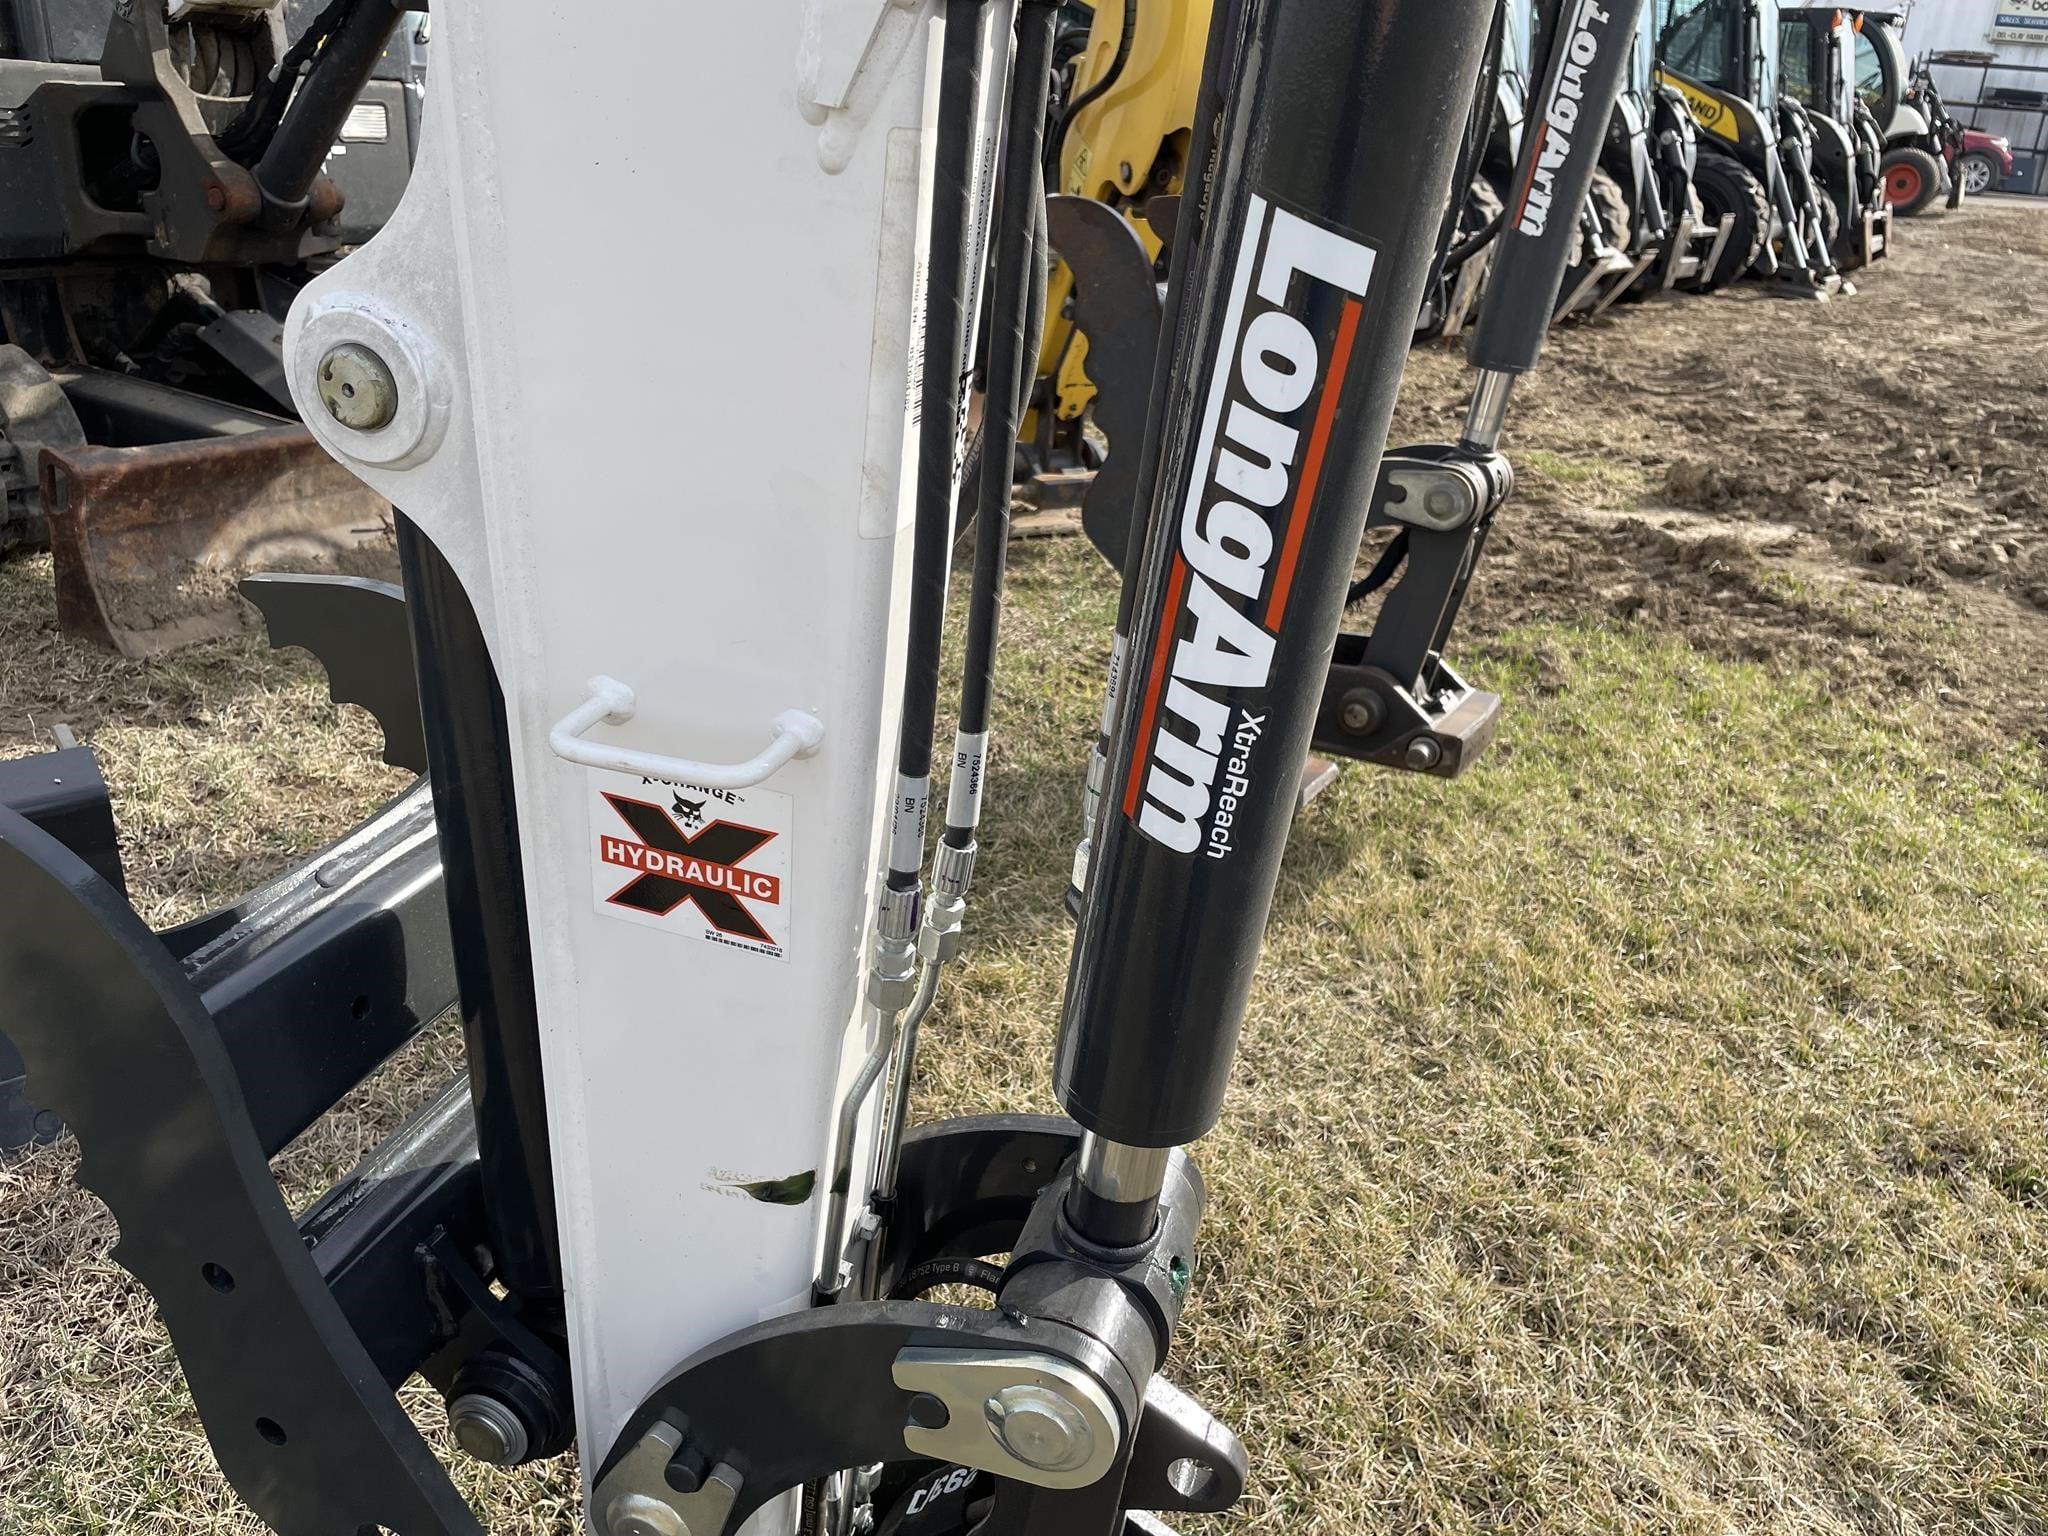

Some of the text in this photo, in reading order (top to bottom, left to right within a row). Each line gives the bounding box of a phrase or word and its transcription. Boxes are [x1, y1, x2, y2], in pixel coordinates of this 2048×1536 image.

[1518, 0, 1610, 237] LongArm
[1140, 195, 1377, 857] LongArm
[957, 752, 967, 768] BN
[1207, 708, 1266, 859] XtraReach
[904, 797, 915, 814] BN
[607, 840, 772, 898] HYDRAULIC
[932, 1263, 951, 1275] Type
[953, 1262, 960, 1272] B
